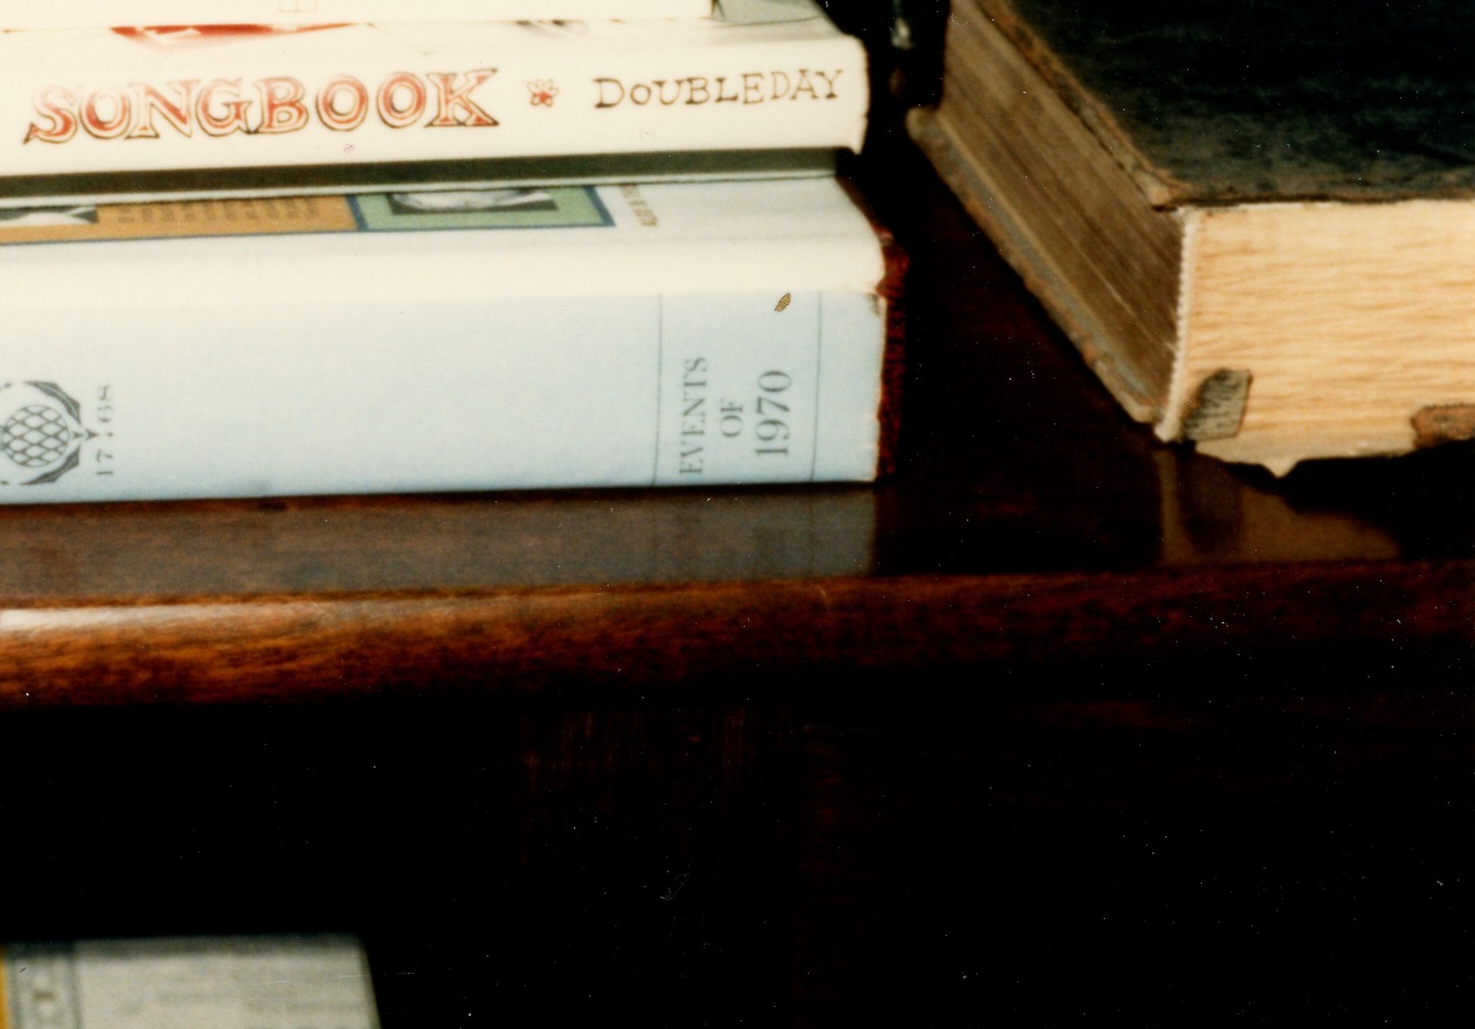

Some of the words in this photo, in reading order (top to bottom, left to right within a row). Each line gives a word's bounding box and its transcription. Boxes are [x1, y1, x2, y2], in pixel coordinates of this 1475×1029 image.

[23, 68, 500, 144] SONGBOOK
[678, 356, 708, 475] EVENTS
[720, 398, 744, 438] OF
[754, 369, 792, 457] 1970
